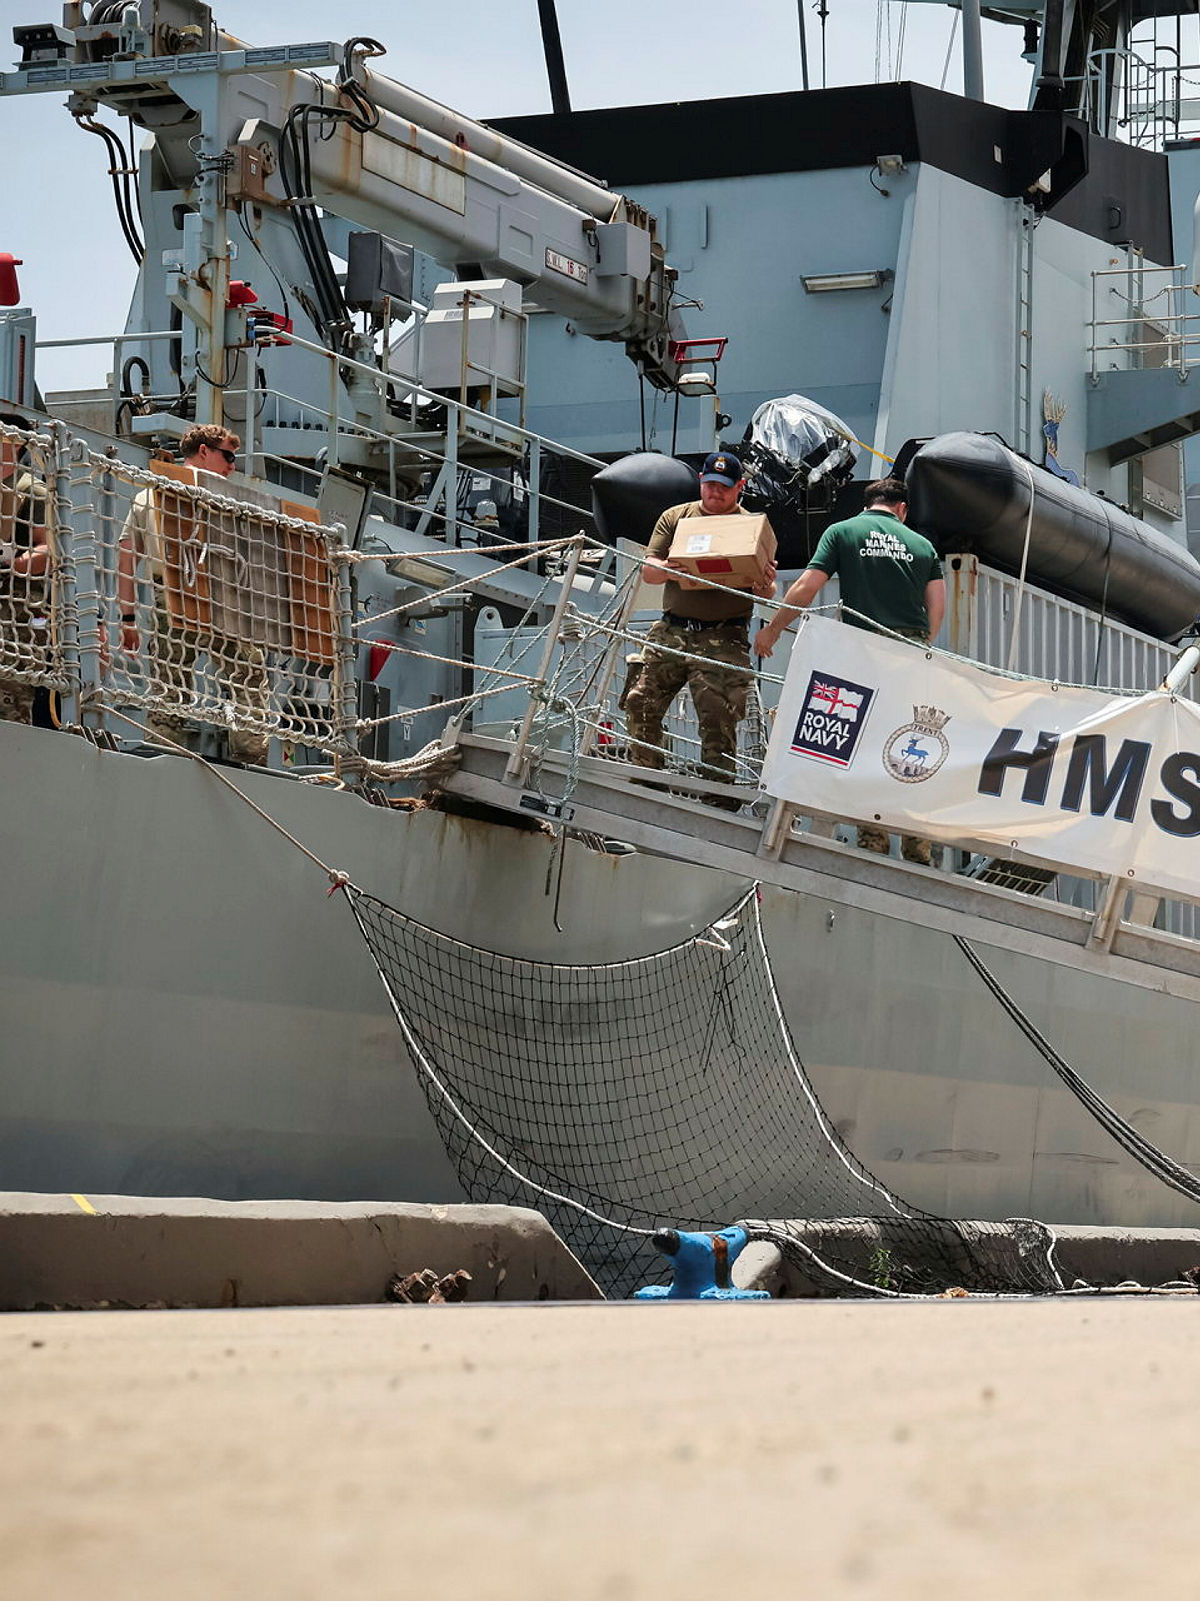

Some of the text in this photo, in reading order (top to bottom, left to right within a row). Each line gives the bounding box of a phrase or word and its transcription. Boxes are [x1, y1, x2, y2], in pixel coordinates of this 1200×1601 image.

[870, 531, 900, 543] ROYAL
[865, 539, 907, 552] MARINES
[859, 548, 914, 562] COMMANDO
[803, 711, 851, 737] ROYAL
[912, 724, 939, 735] TRENT
[799, 726, 849, 750] NAVY
